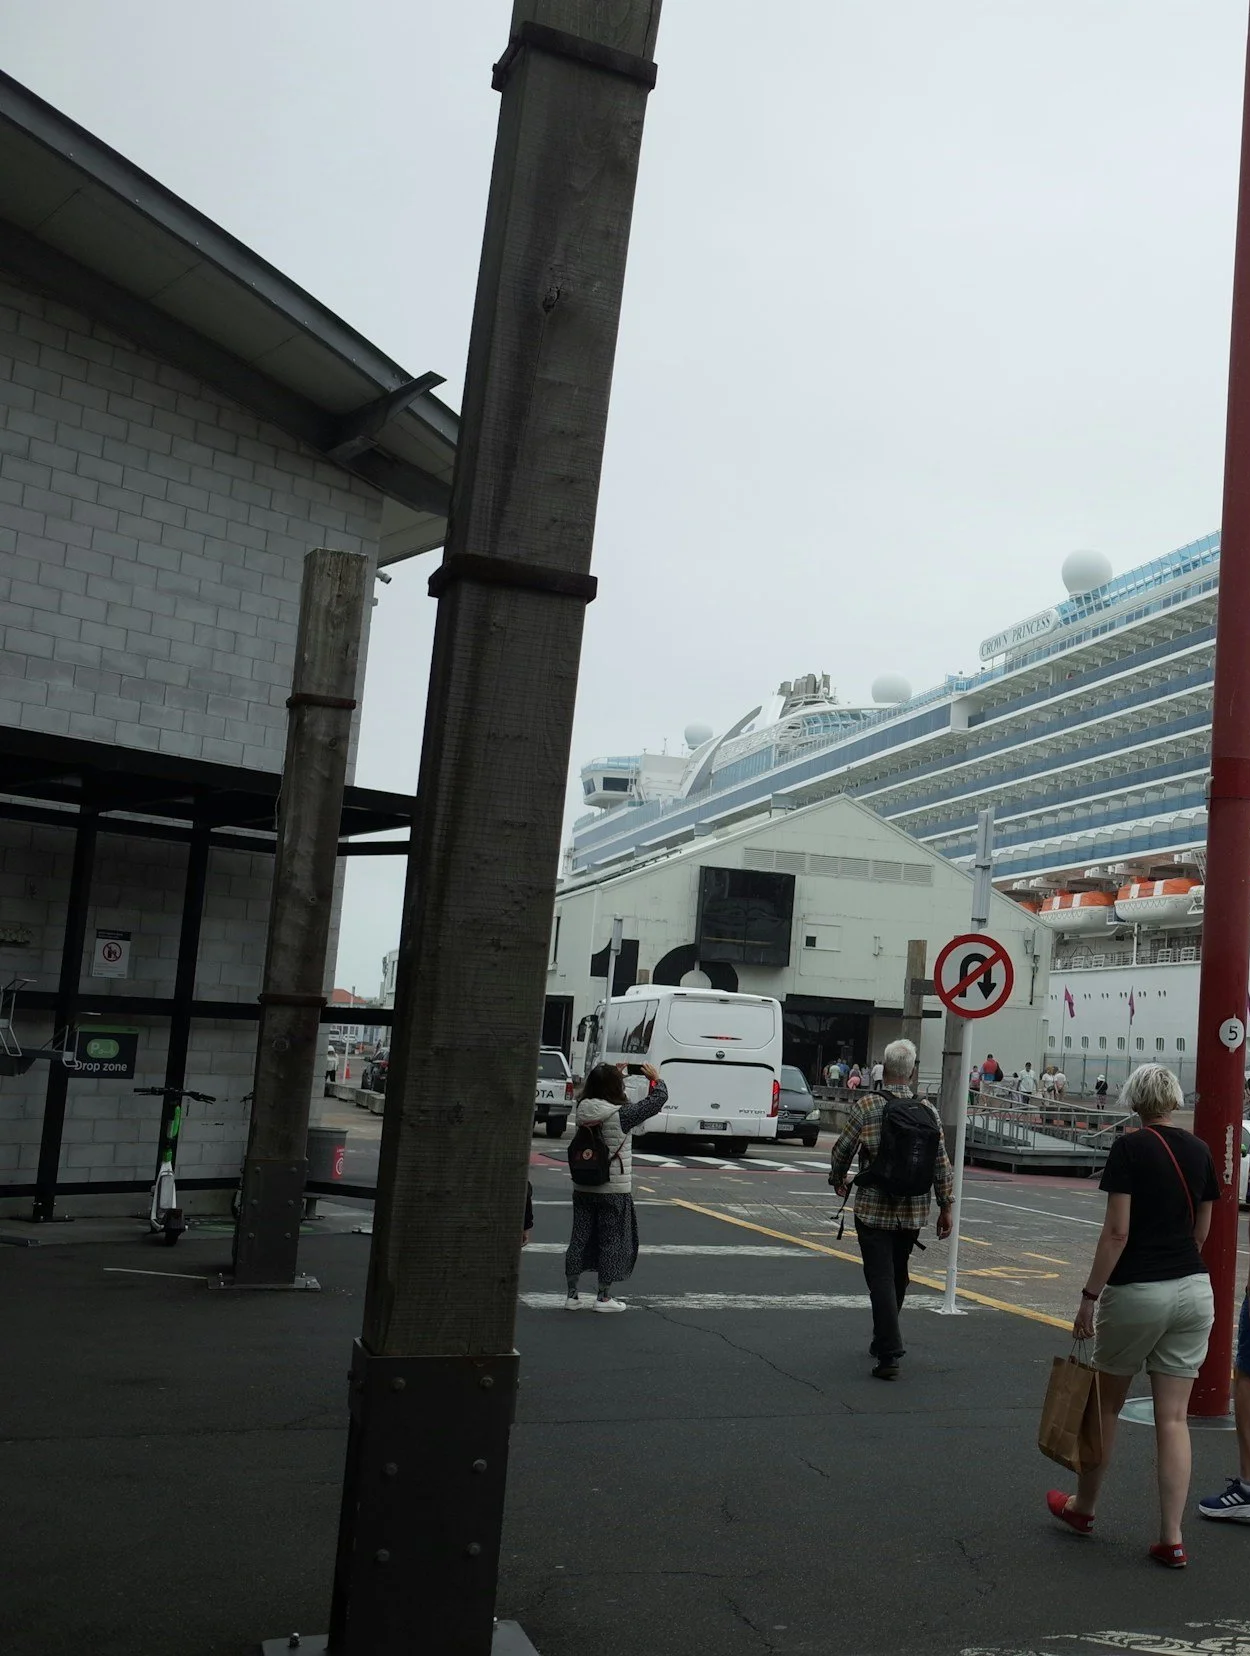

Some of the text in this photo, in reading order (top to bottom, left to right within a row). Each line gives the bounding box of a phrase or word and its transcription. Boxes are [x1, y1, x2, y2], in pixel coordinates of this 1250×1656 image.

[981, 614, 1051, 657] CROWN PRINCESS
[1228, 1025, 1238, 1041] 5
[74, 1060, 128, 1073] Drop zone
